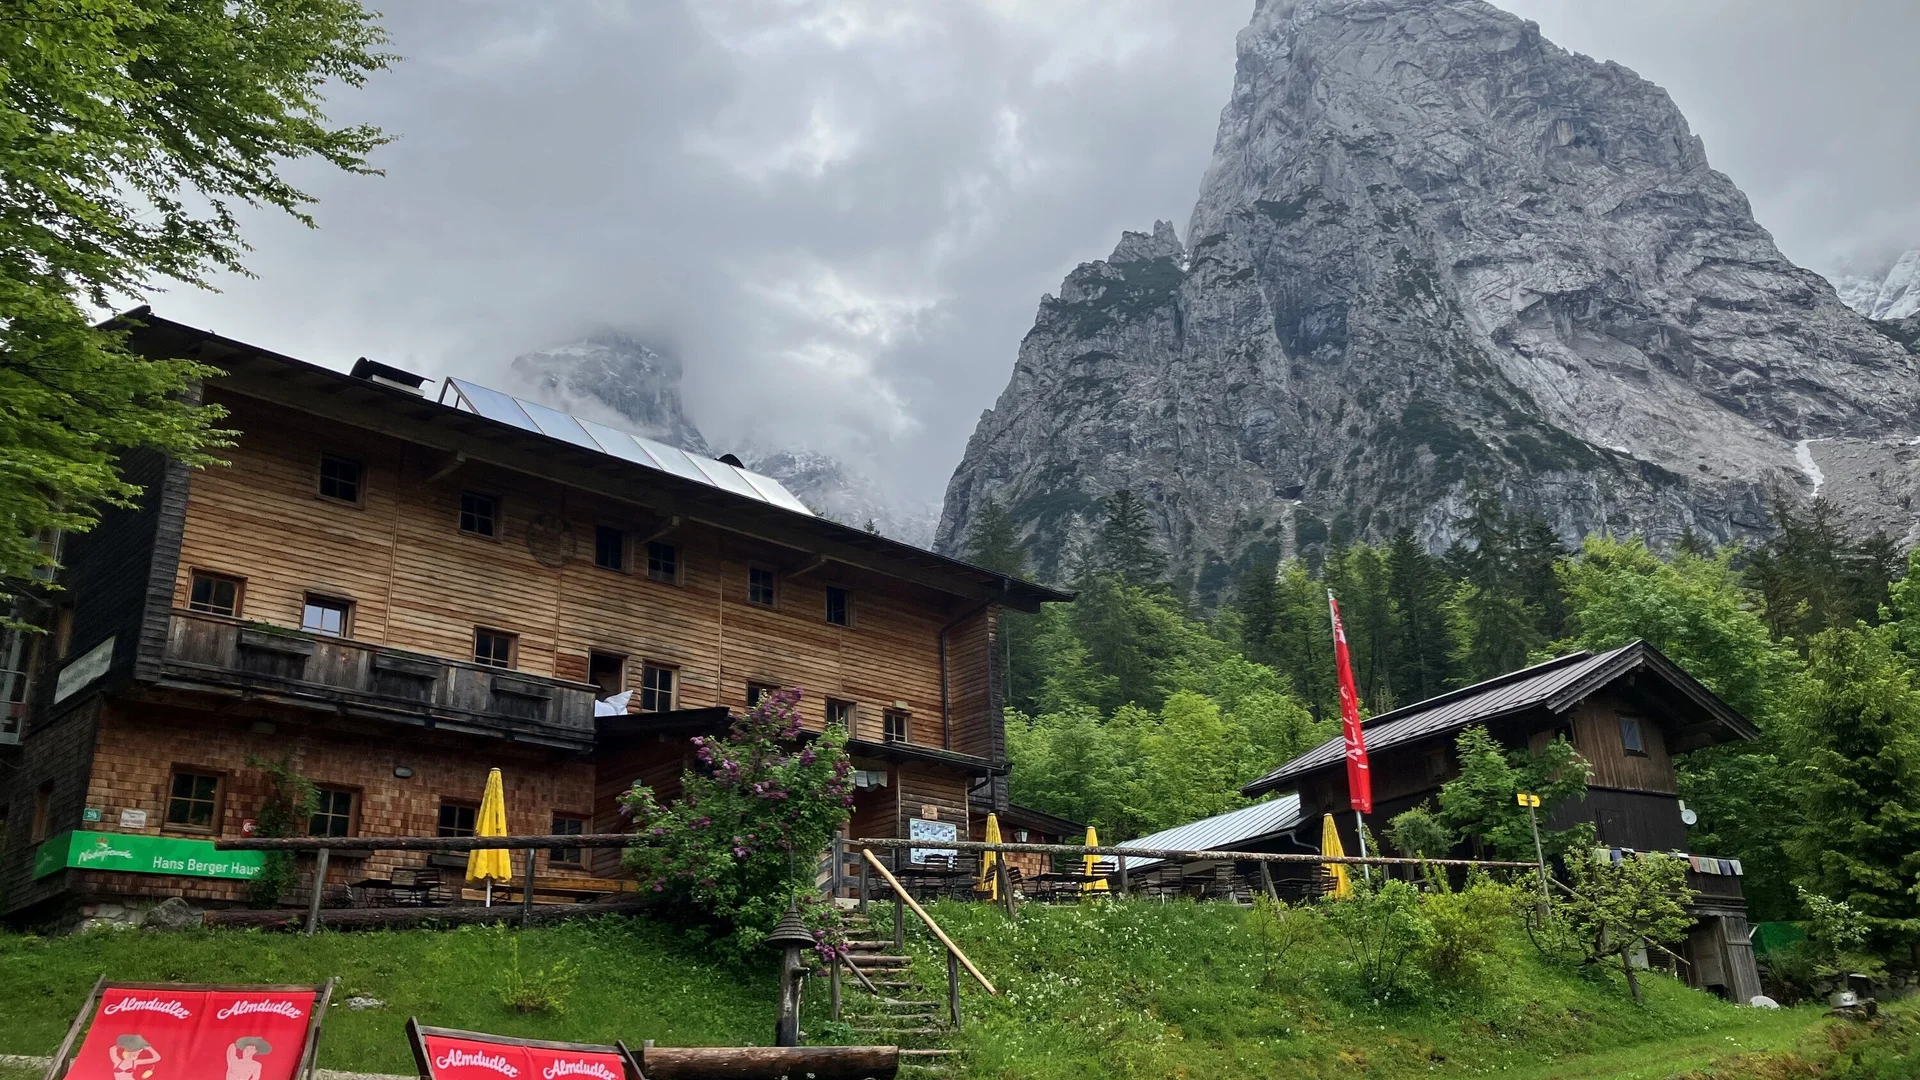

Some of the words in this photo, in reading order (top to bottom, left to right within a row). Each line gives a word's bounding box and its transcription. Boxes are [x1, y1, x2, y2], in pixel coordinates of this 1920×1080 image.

[153, 857, 184, 870] Hans
[187, 859, 228, 875] Berger
[230, 862, 261, 875] Haus
[104, 997, 190, 1019] Almdudler
[217, 999, 301, 1019] Almdudler
[433, 1048, 518, 1078] Almdudler
[542, 1059, 615, 1080] Almdudler
